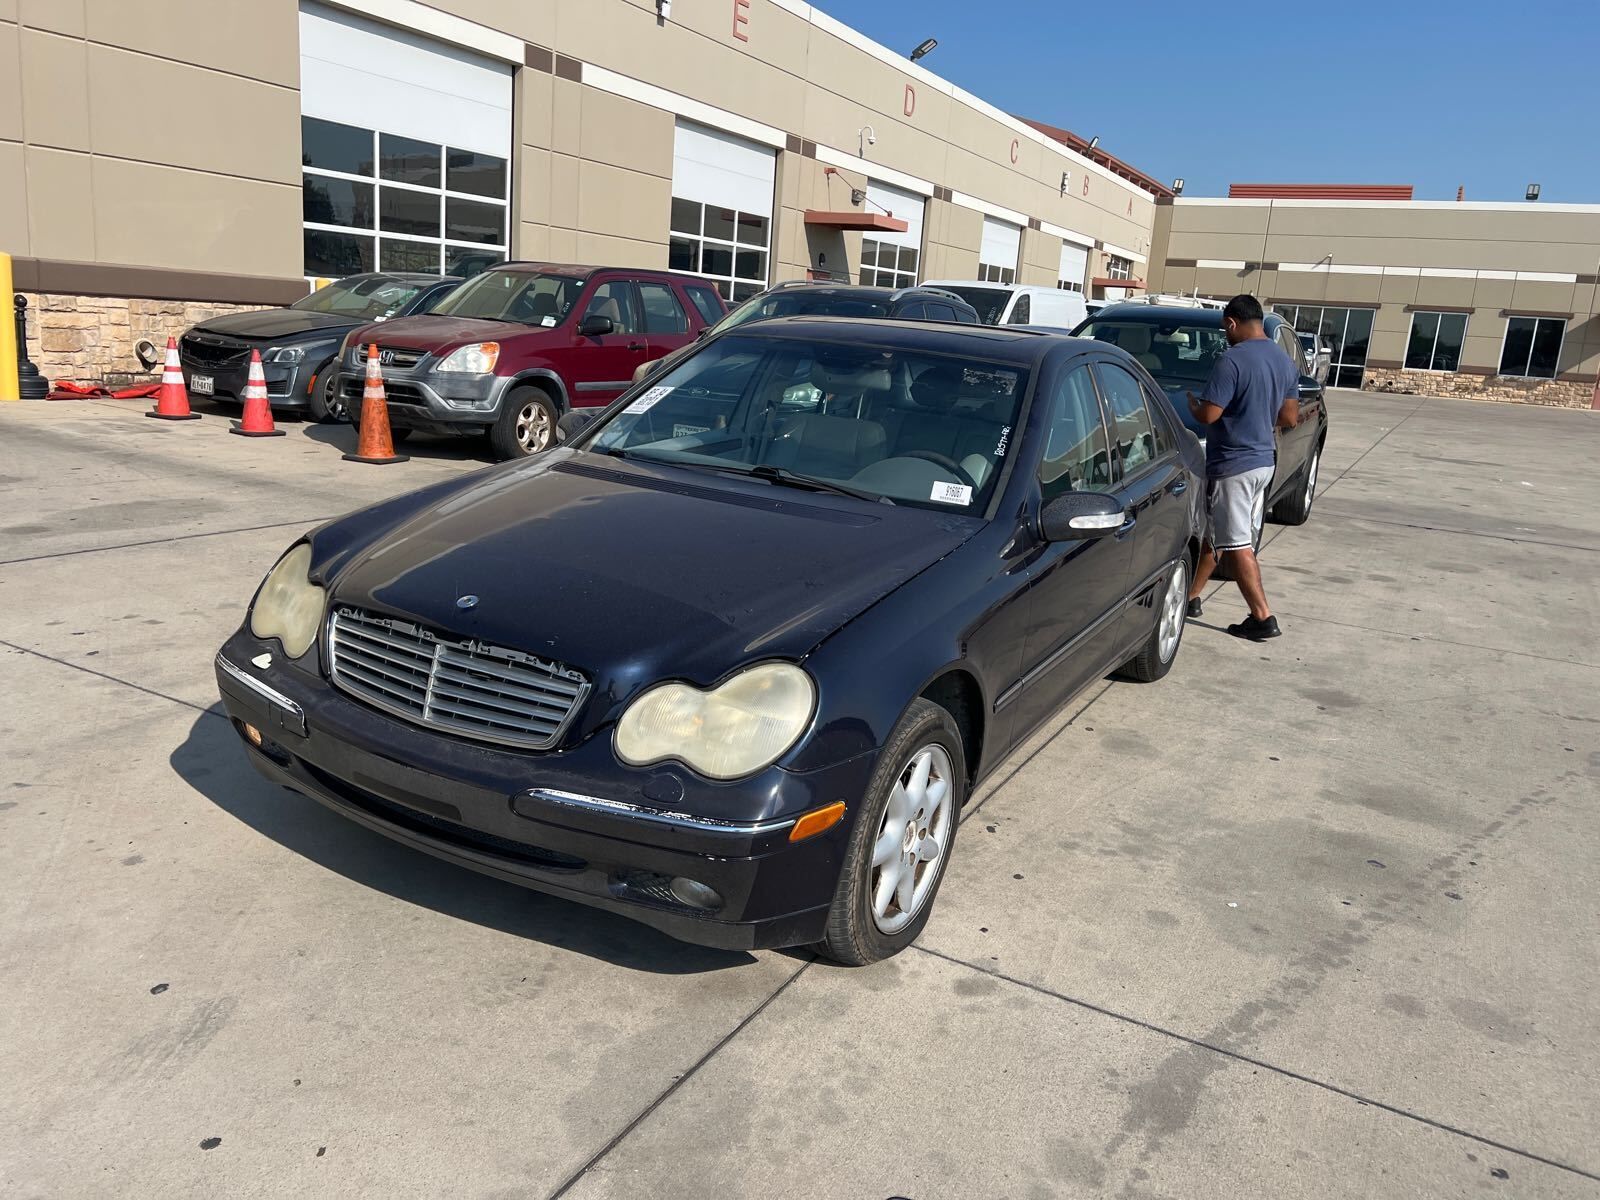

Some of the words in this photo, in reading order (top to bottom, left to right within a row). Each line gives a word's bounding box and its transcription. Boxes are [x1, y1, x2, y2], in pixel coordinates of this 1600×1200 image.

[733, 0, 750, 42] E
[903, 83, 915, 117] D
[1010, 138, 1019, 165] C
[1082, 174, 1090, 197] B
[1127, 197, 1133, 217] A
